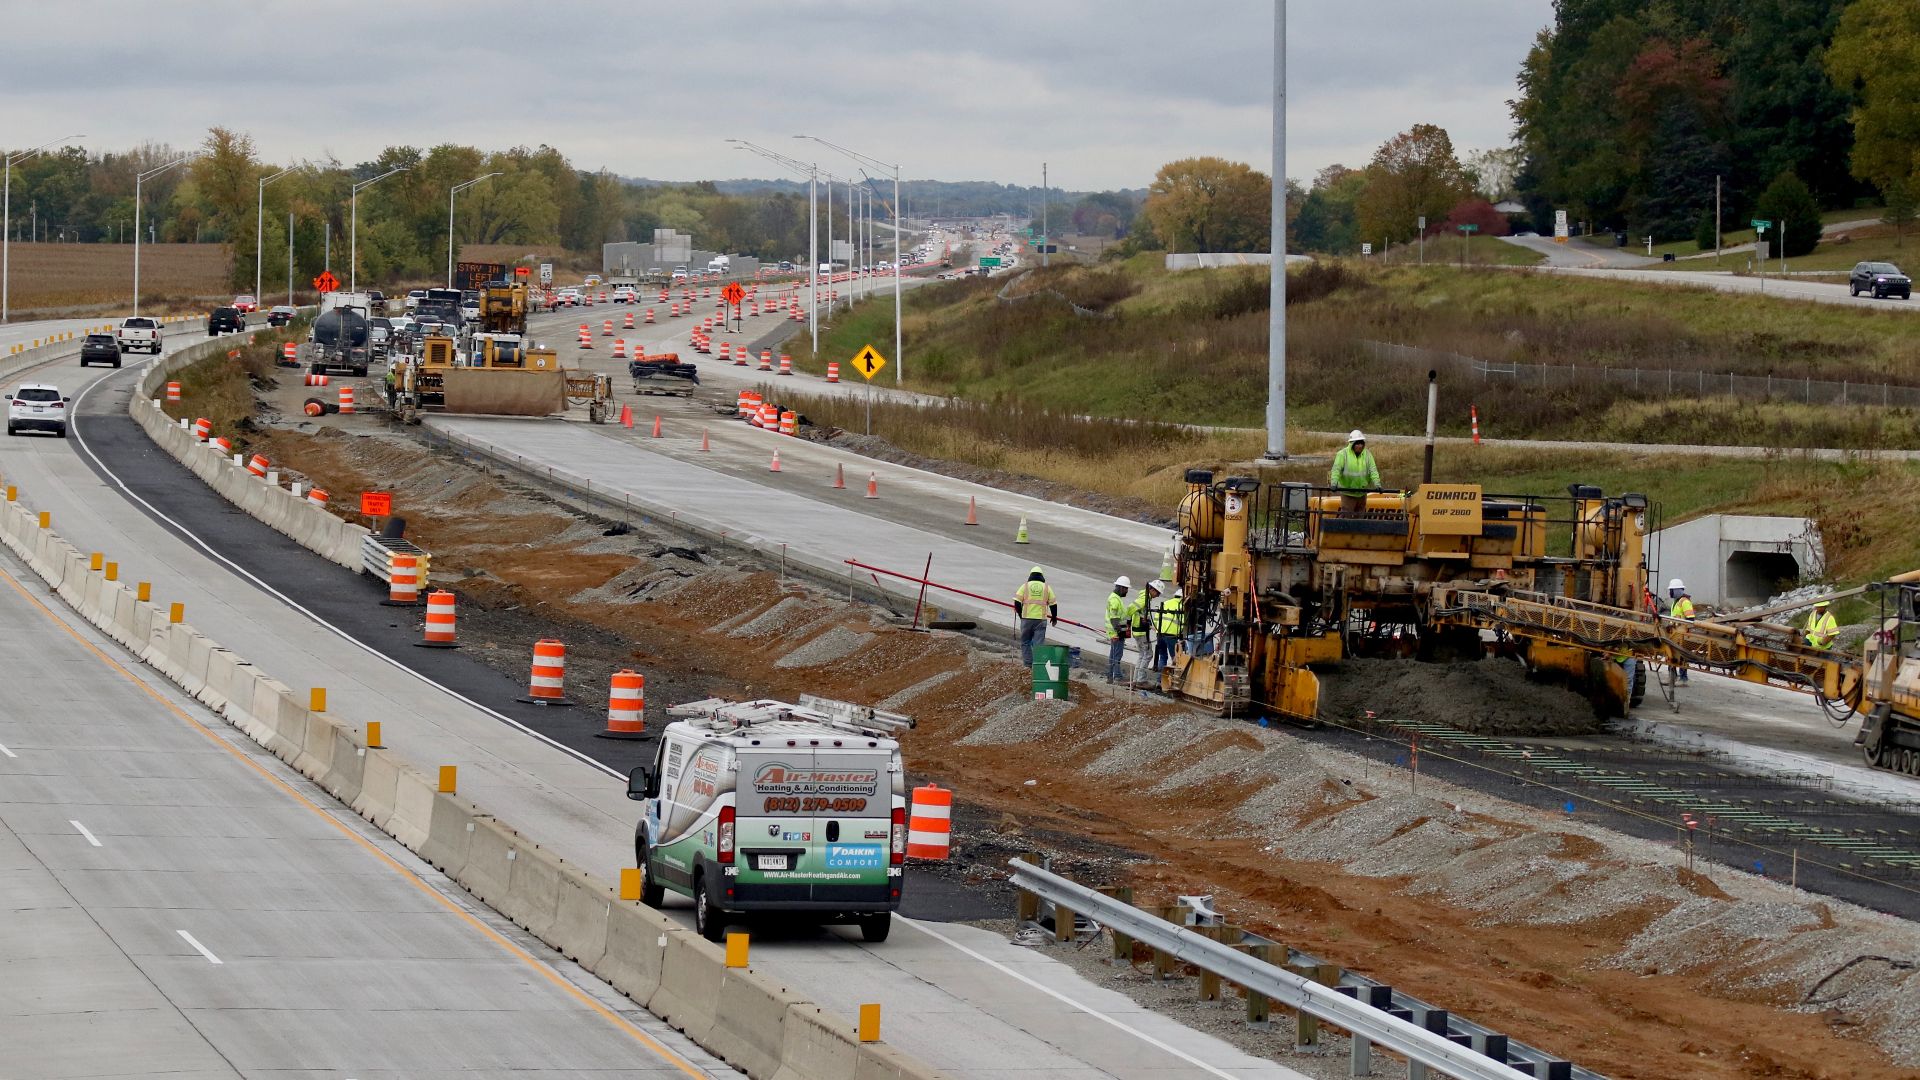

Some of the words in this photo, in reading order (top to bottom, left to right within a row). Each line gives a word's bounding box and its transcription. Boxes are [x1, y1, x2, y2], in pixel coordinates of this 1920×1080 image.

[459, 264, 481, 272] STAY
[469, 273, 493, 281] LEFT
[1426, 490, 1476, 500] GOMACO
[756, 768, 874, 783] Air-Master
[757, 785, 792, 793] Heating
[819, 785, 873, 793] Conditioning
[764, 797, 800, 812] (812)
[802, 798, 866, 811] 279-0509
[841, 848, 875, 856] DAIKIN
